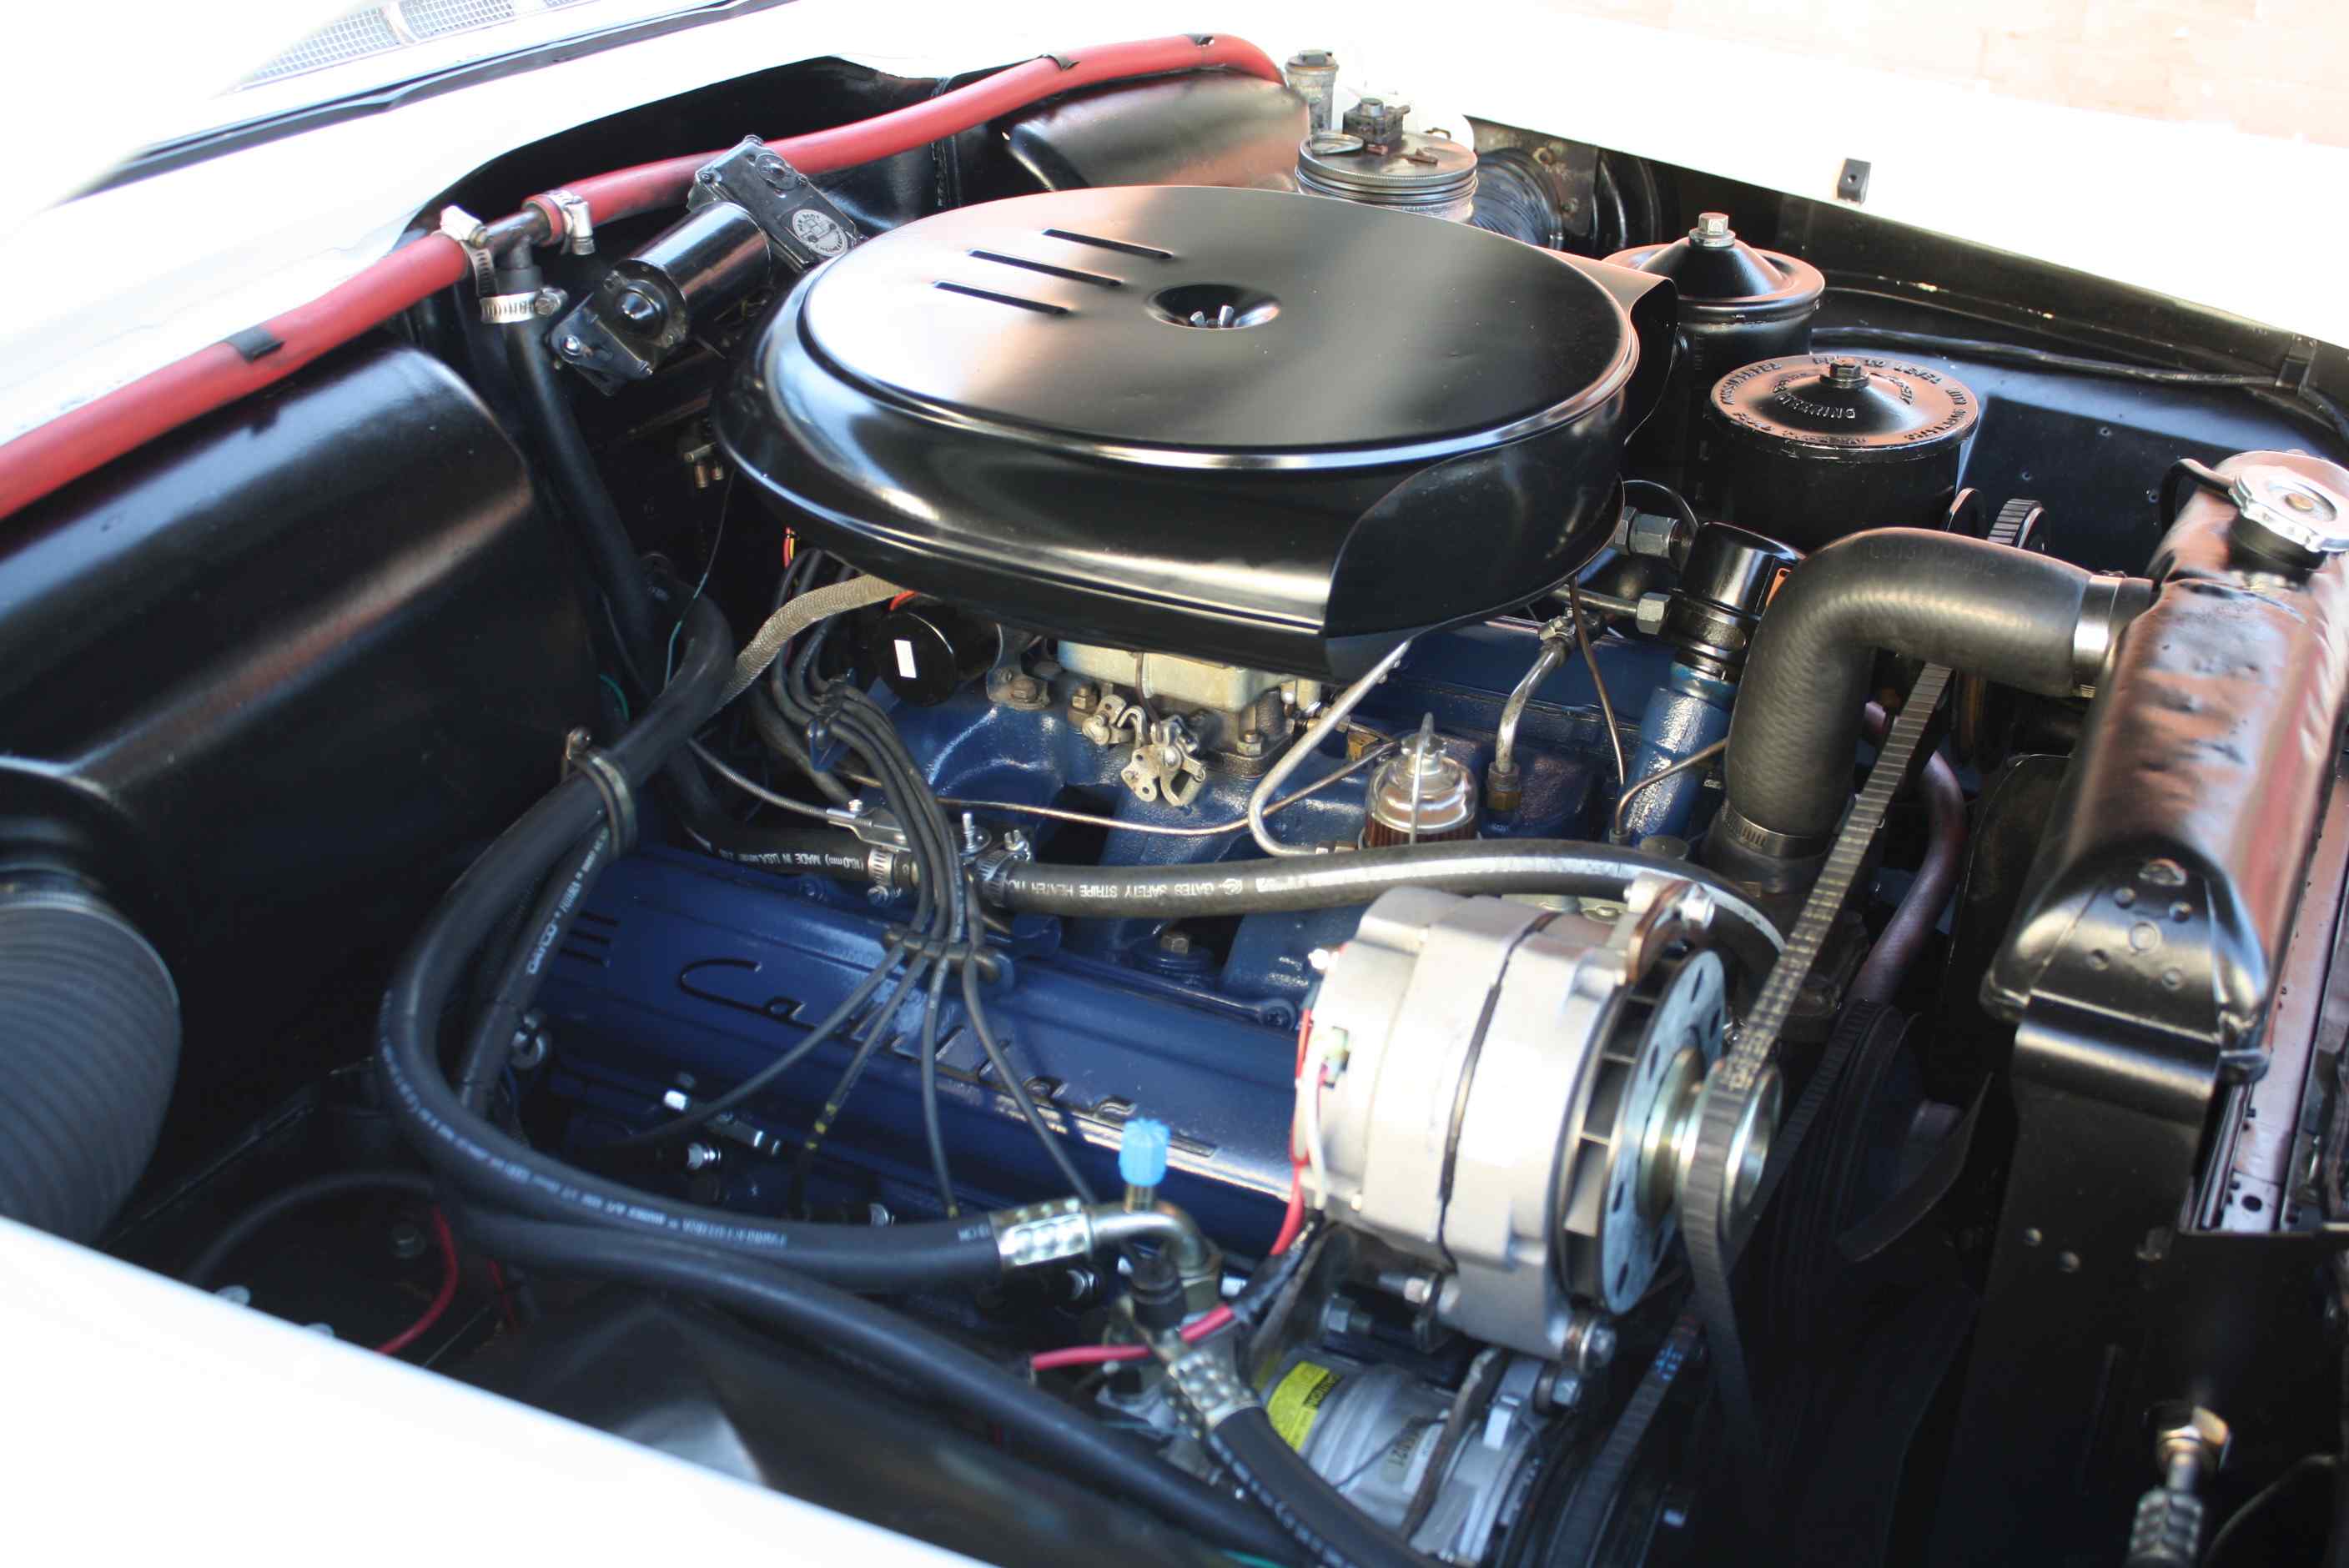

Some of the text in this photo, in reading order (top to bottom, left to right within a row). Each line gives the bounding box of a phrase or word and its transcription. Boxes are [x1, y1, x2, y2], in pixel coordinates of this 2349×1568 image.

[782, 852, 792, 864] IN
[794, 852, 822, 866] MADE
[1079, 884, 1119, 898] STRIPE
[1124, 883, 1168, 898] SAFETY
[1174, 882, 1215, 897] GATES
